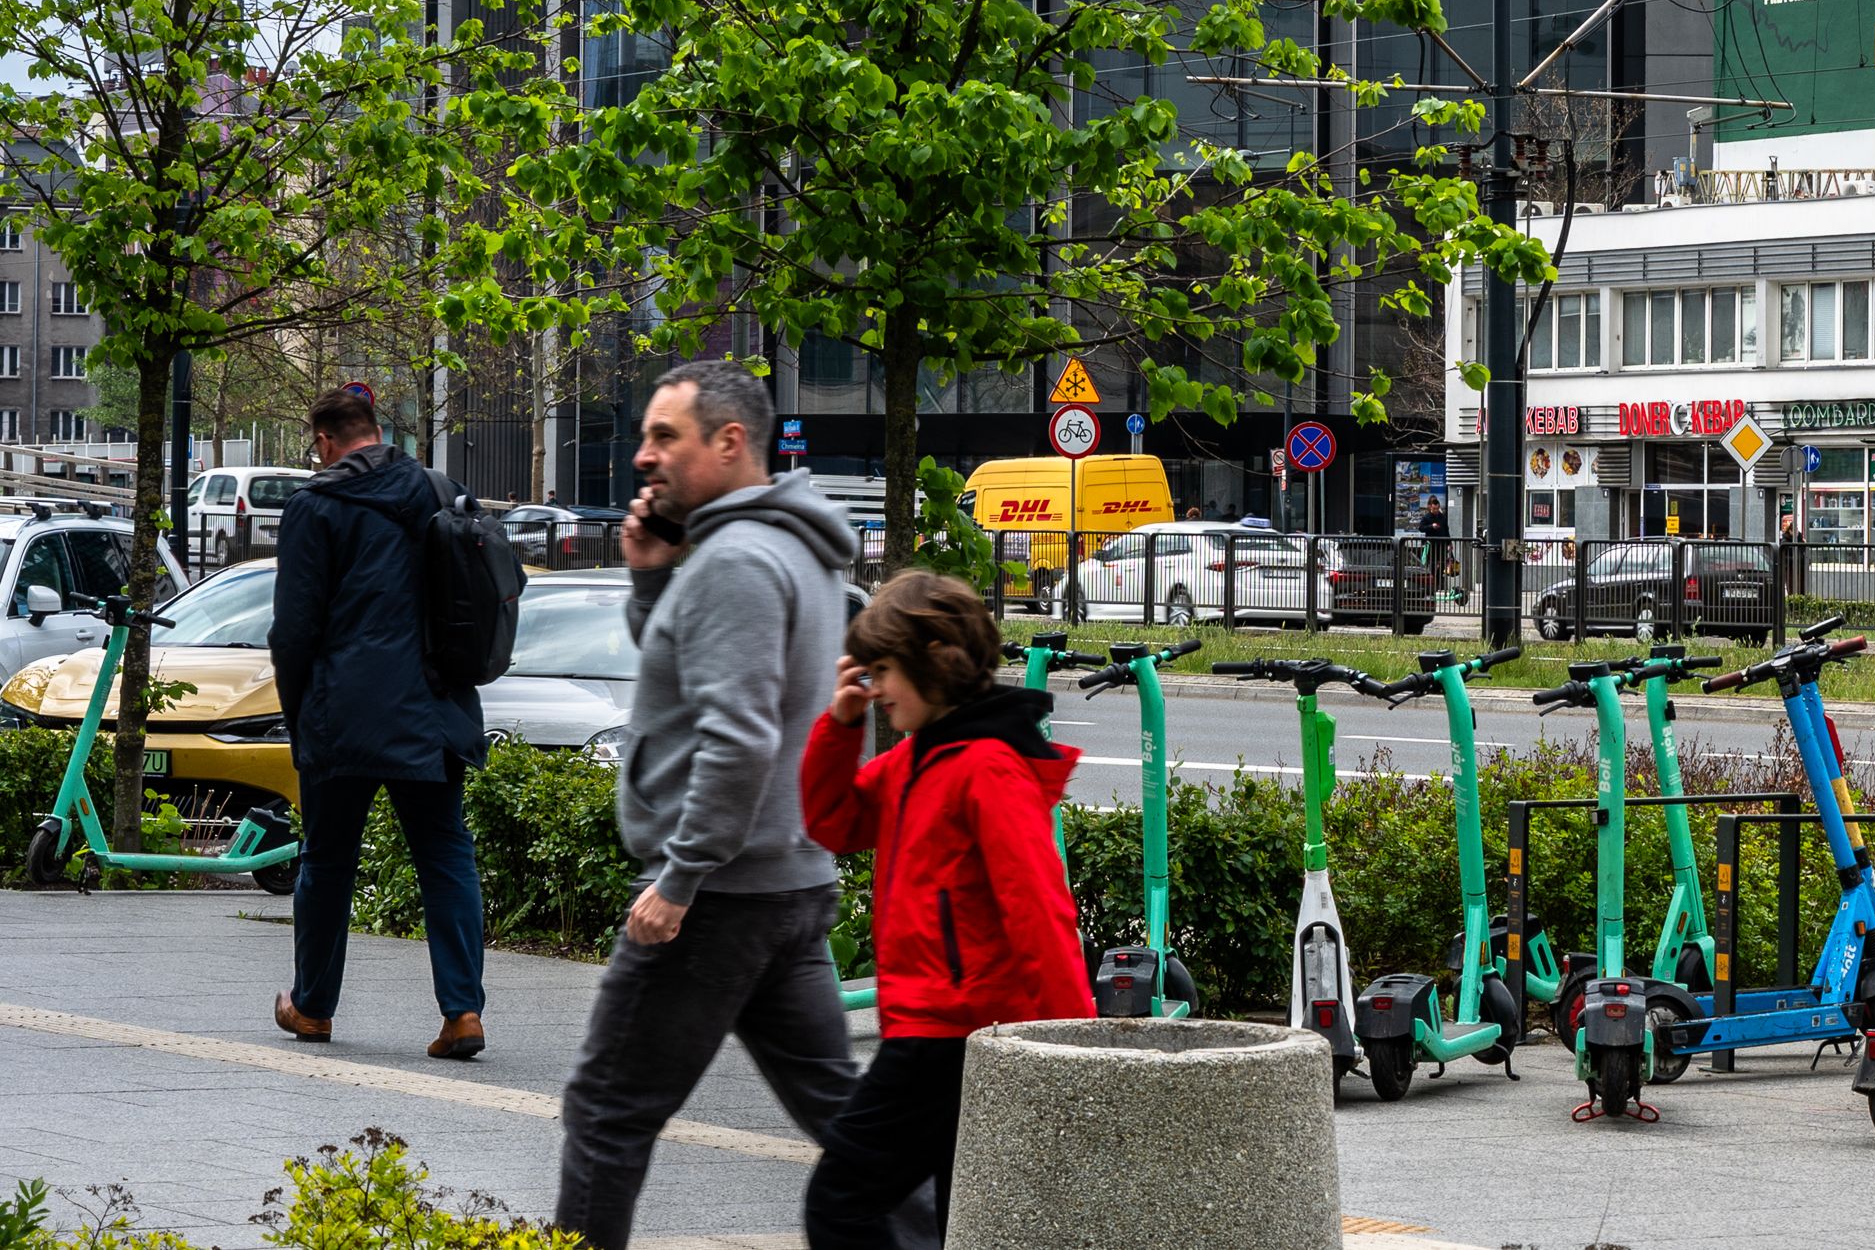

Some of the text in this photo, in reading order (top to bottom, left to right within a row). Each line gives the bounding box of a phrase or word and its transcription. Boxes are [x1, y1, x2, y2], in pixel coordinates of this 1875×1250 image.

[1525, 405, 1579, 435] KEBAB
[1619, 401, 1670, 436] DONER
[998, 499, 1053, 523] DHL
[1102, 500, 1153, 515] DHL
[1142, 730, 1155, 763] Bolt
[1662, 726, 1675, 758] Bolt
[1452, 741, 1464, 777] Bolt
[1599, 758, 1611, 793] Bolt
